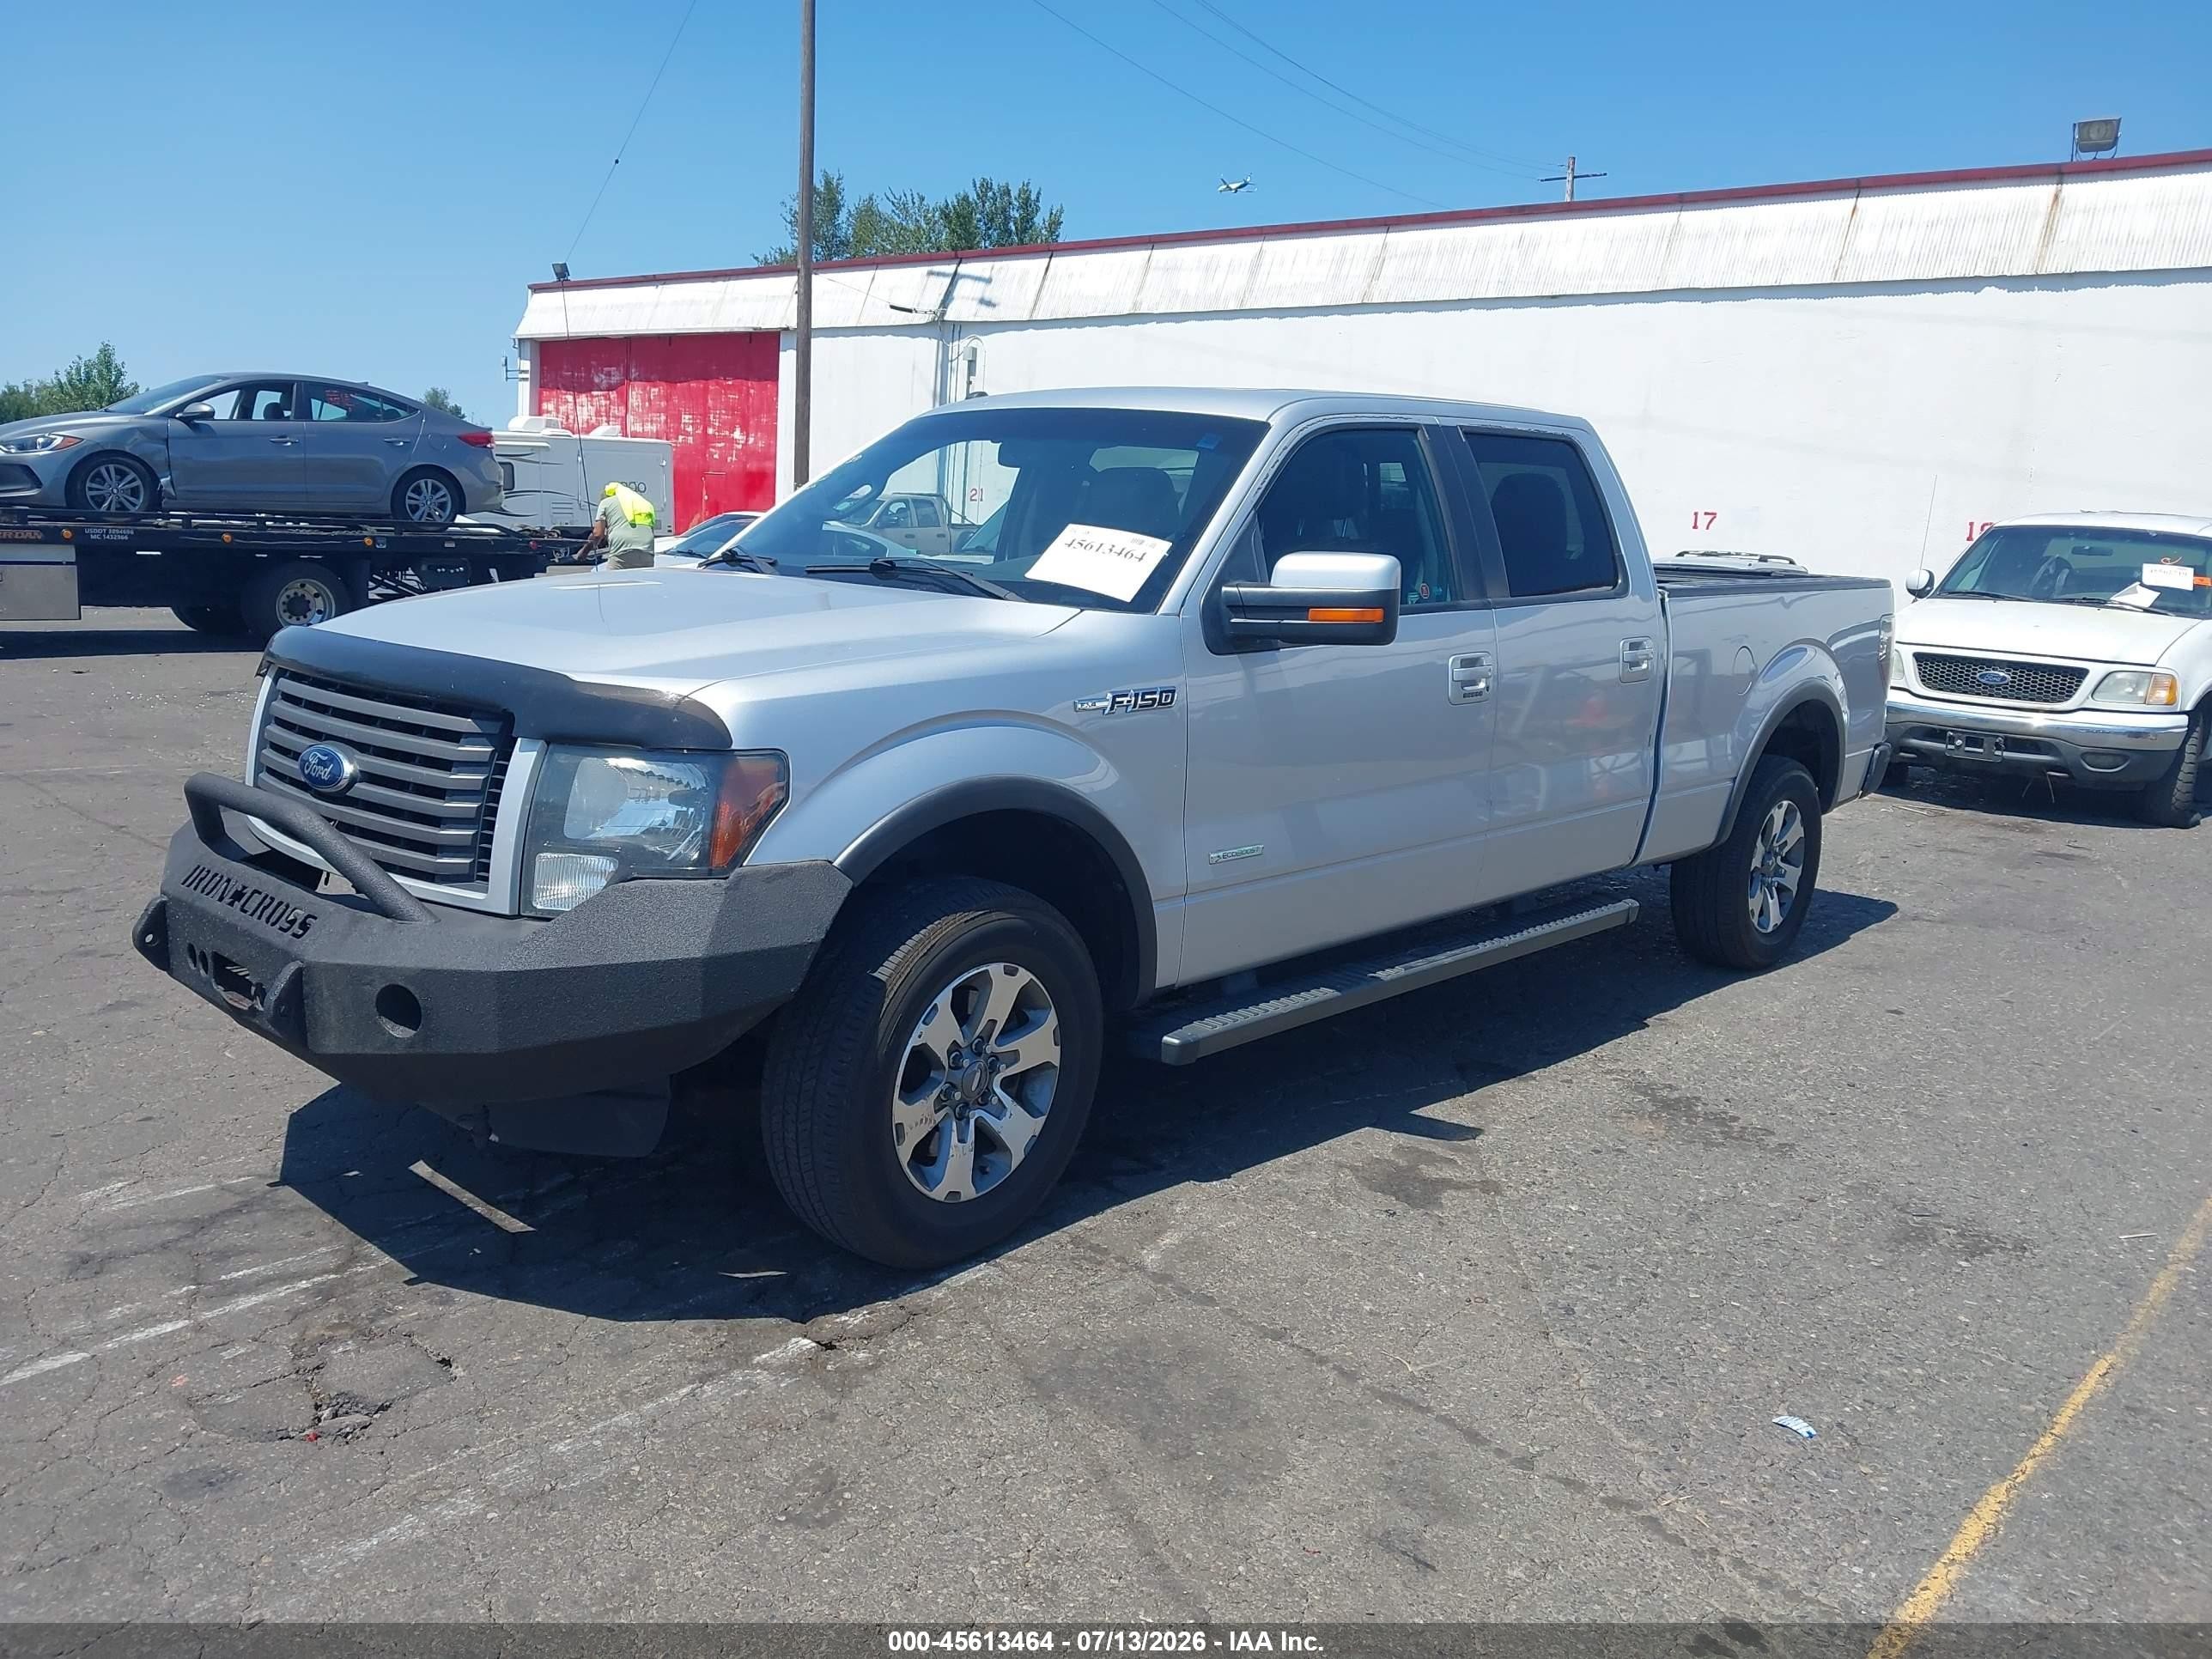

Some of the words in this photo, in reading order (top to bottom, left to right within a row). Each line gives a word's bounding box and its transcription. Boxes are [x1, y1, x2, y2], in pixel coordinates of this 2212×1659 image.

[969, 488, 983, 501] 21
[1692, 511, 1717, 530] 17
[1065, 538, 1147, 562] 45613464
[304, 751, 334, 781] Ford
[180, 864, 236, 902] IRON
[239, 889, 318, 939] CROSS
